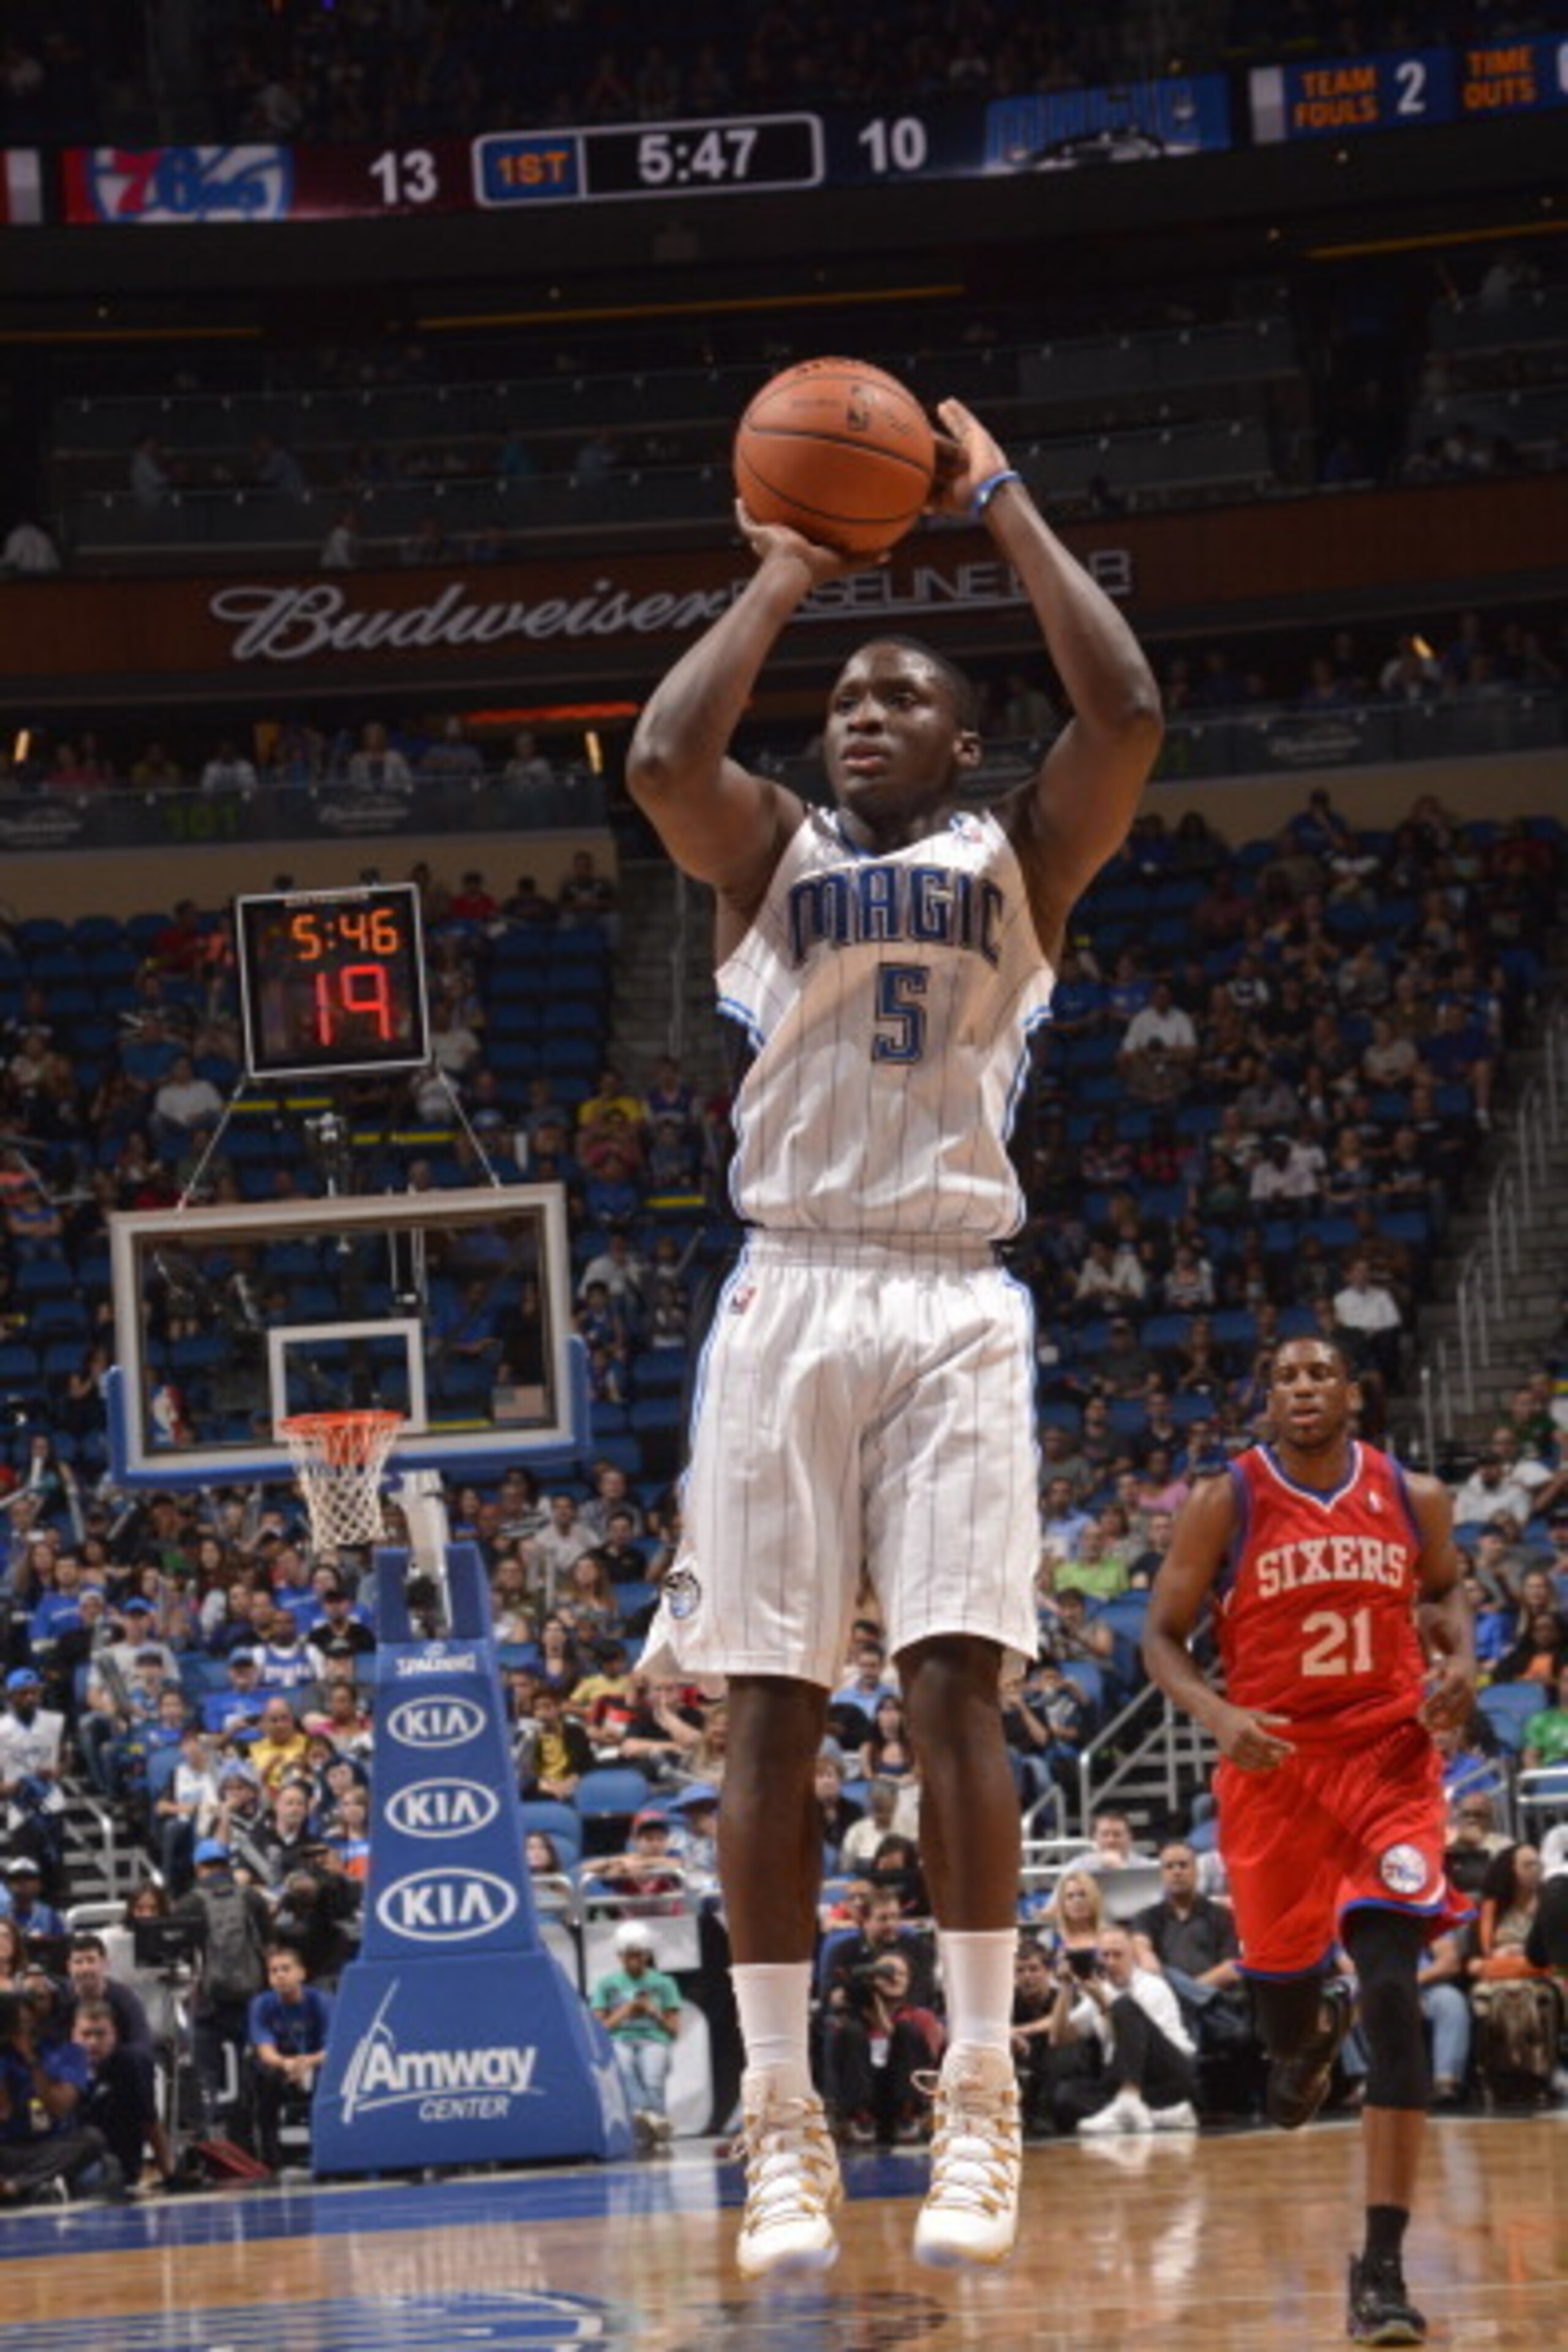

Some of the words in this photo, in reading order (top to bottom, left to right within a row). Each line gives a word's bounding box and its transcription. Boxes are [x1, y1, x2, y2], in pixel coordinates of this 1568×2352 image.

[1302, 66, 1377, 97] TEAM
[1396, 60, 1426, 115] 2
[1468, 47, 1531, 75] TIME
[1295, 95, 1378, 127] FOULS
[1464, 78, 1535, 109] OUTS
[498, 151, 569, 184] 1ST
[638, 128, 758, 183] 5:47
[859, 118, 926, 173] 10
[371, 149, 439, 204] 13
[209, 579, 729, 662] Budweiser
[292, 908, 398, 959] 5:46
[789, 866, 1005, 971] MAGIC
[316, 963, 392, 1046] 19
[871, 960, 930, 1065] 5
[1257, 1535, 1406, 1600] SIXERS
[1302, 1607, 1373, 1677] 21
[404, 1707, 469, 1737] KIA
[404, 1789, 480, 1827] KIA
[401, 1882, 495, 1926] KIA
[361, 2041, 538, 2095] Amway
[419, 2094, 511, 2123] CENTER
